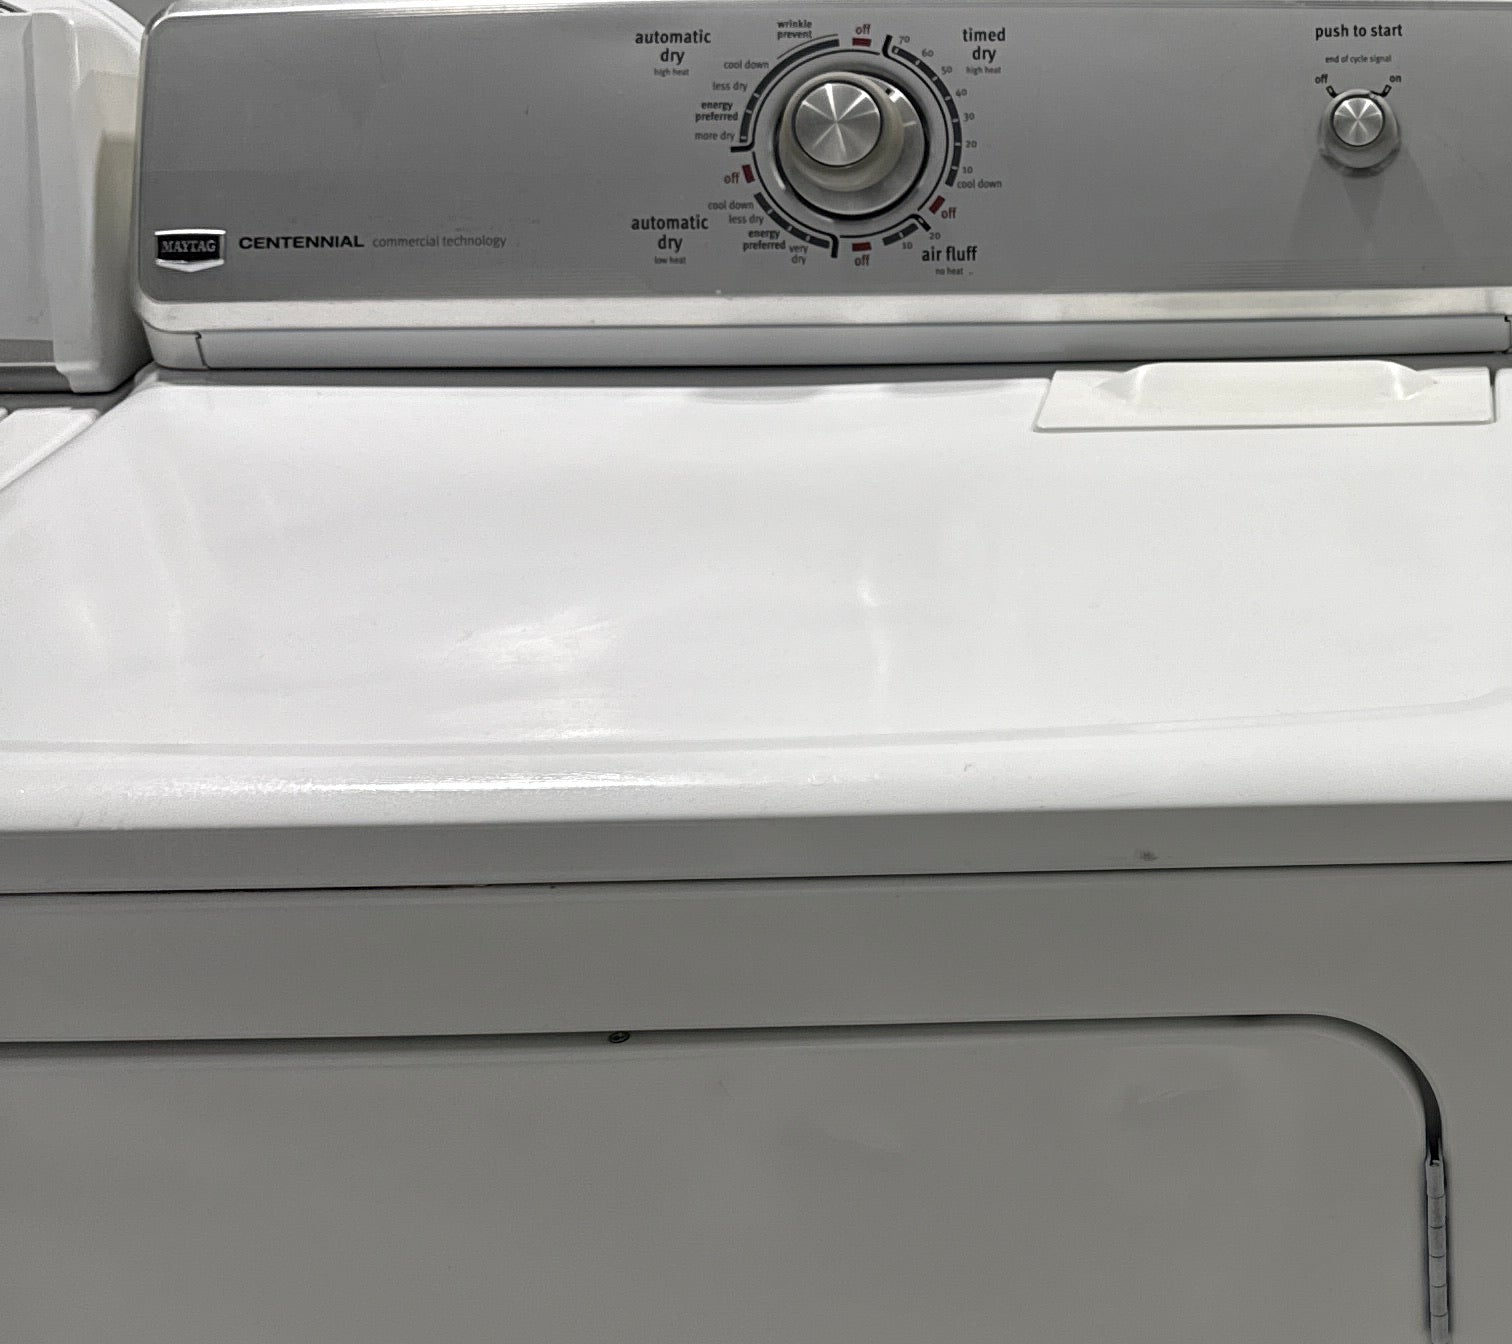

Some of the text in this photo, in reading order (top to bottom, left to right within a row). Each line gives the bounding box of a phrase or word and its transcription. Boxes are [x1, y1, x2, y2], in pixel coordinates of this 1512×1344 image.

[777, 19, 812, 29] wrinkle
[855, 23, 871, 35] off
[634, 29, 712, 44] automatic
[777, 30, 812, 40] prevent
[962, 27, 1006, 42] timed
[1315, 24, 1403, 41] push to start
[899, 35, 911, 45] 70
[660, 47, 686, 65] dry
[921, 48, 935, 58] 60
[972, 46, 997, 64] dry
[723, 59, 770, 70] cool down
[1325, 54, 1392, 64] end of cycle signal
[940, 65, 953, 76] 50
[1314, 73, 1329, 84] off
[1389, 74, 1402, 83] on
[712, 80, 749, 92] less dry
[700, 101, 734, 111] energy
[695, 111, 739, 123] preferred
[963, 112, 976, 122] 30
[694, 130, 736, 142] more dry
[965, 140, 978, 149] 20
[962, 166, 973, 174] 10
[723, 171, 740, 184] off
[956, 178, 1002, 189] cool down
[707, 200, 755, 210] cool down
[941, 207, 957, 219] off
[631, 214, 709, 230] automatic
[728, 214, 765, 226] less dry
[748, 229, 781, 239] energy
[929, 232, 941, 240] 20
[161, 234, 507, 253] MAYTAG CENTENNIAL commercial technology
[657, 234, 683, 253] dry
[742, 240, 809, 254] preferred very
[921, 246, 978, 261] air fluff
[654, 256, 687, 265] low heat
[791, 254, 807, 265] dry
[854, 254, 870, 266] off
[946, 267, 964, 275] heat
